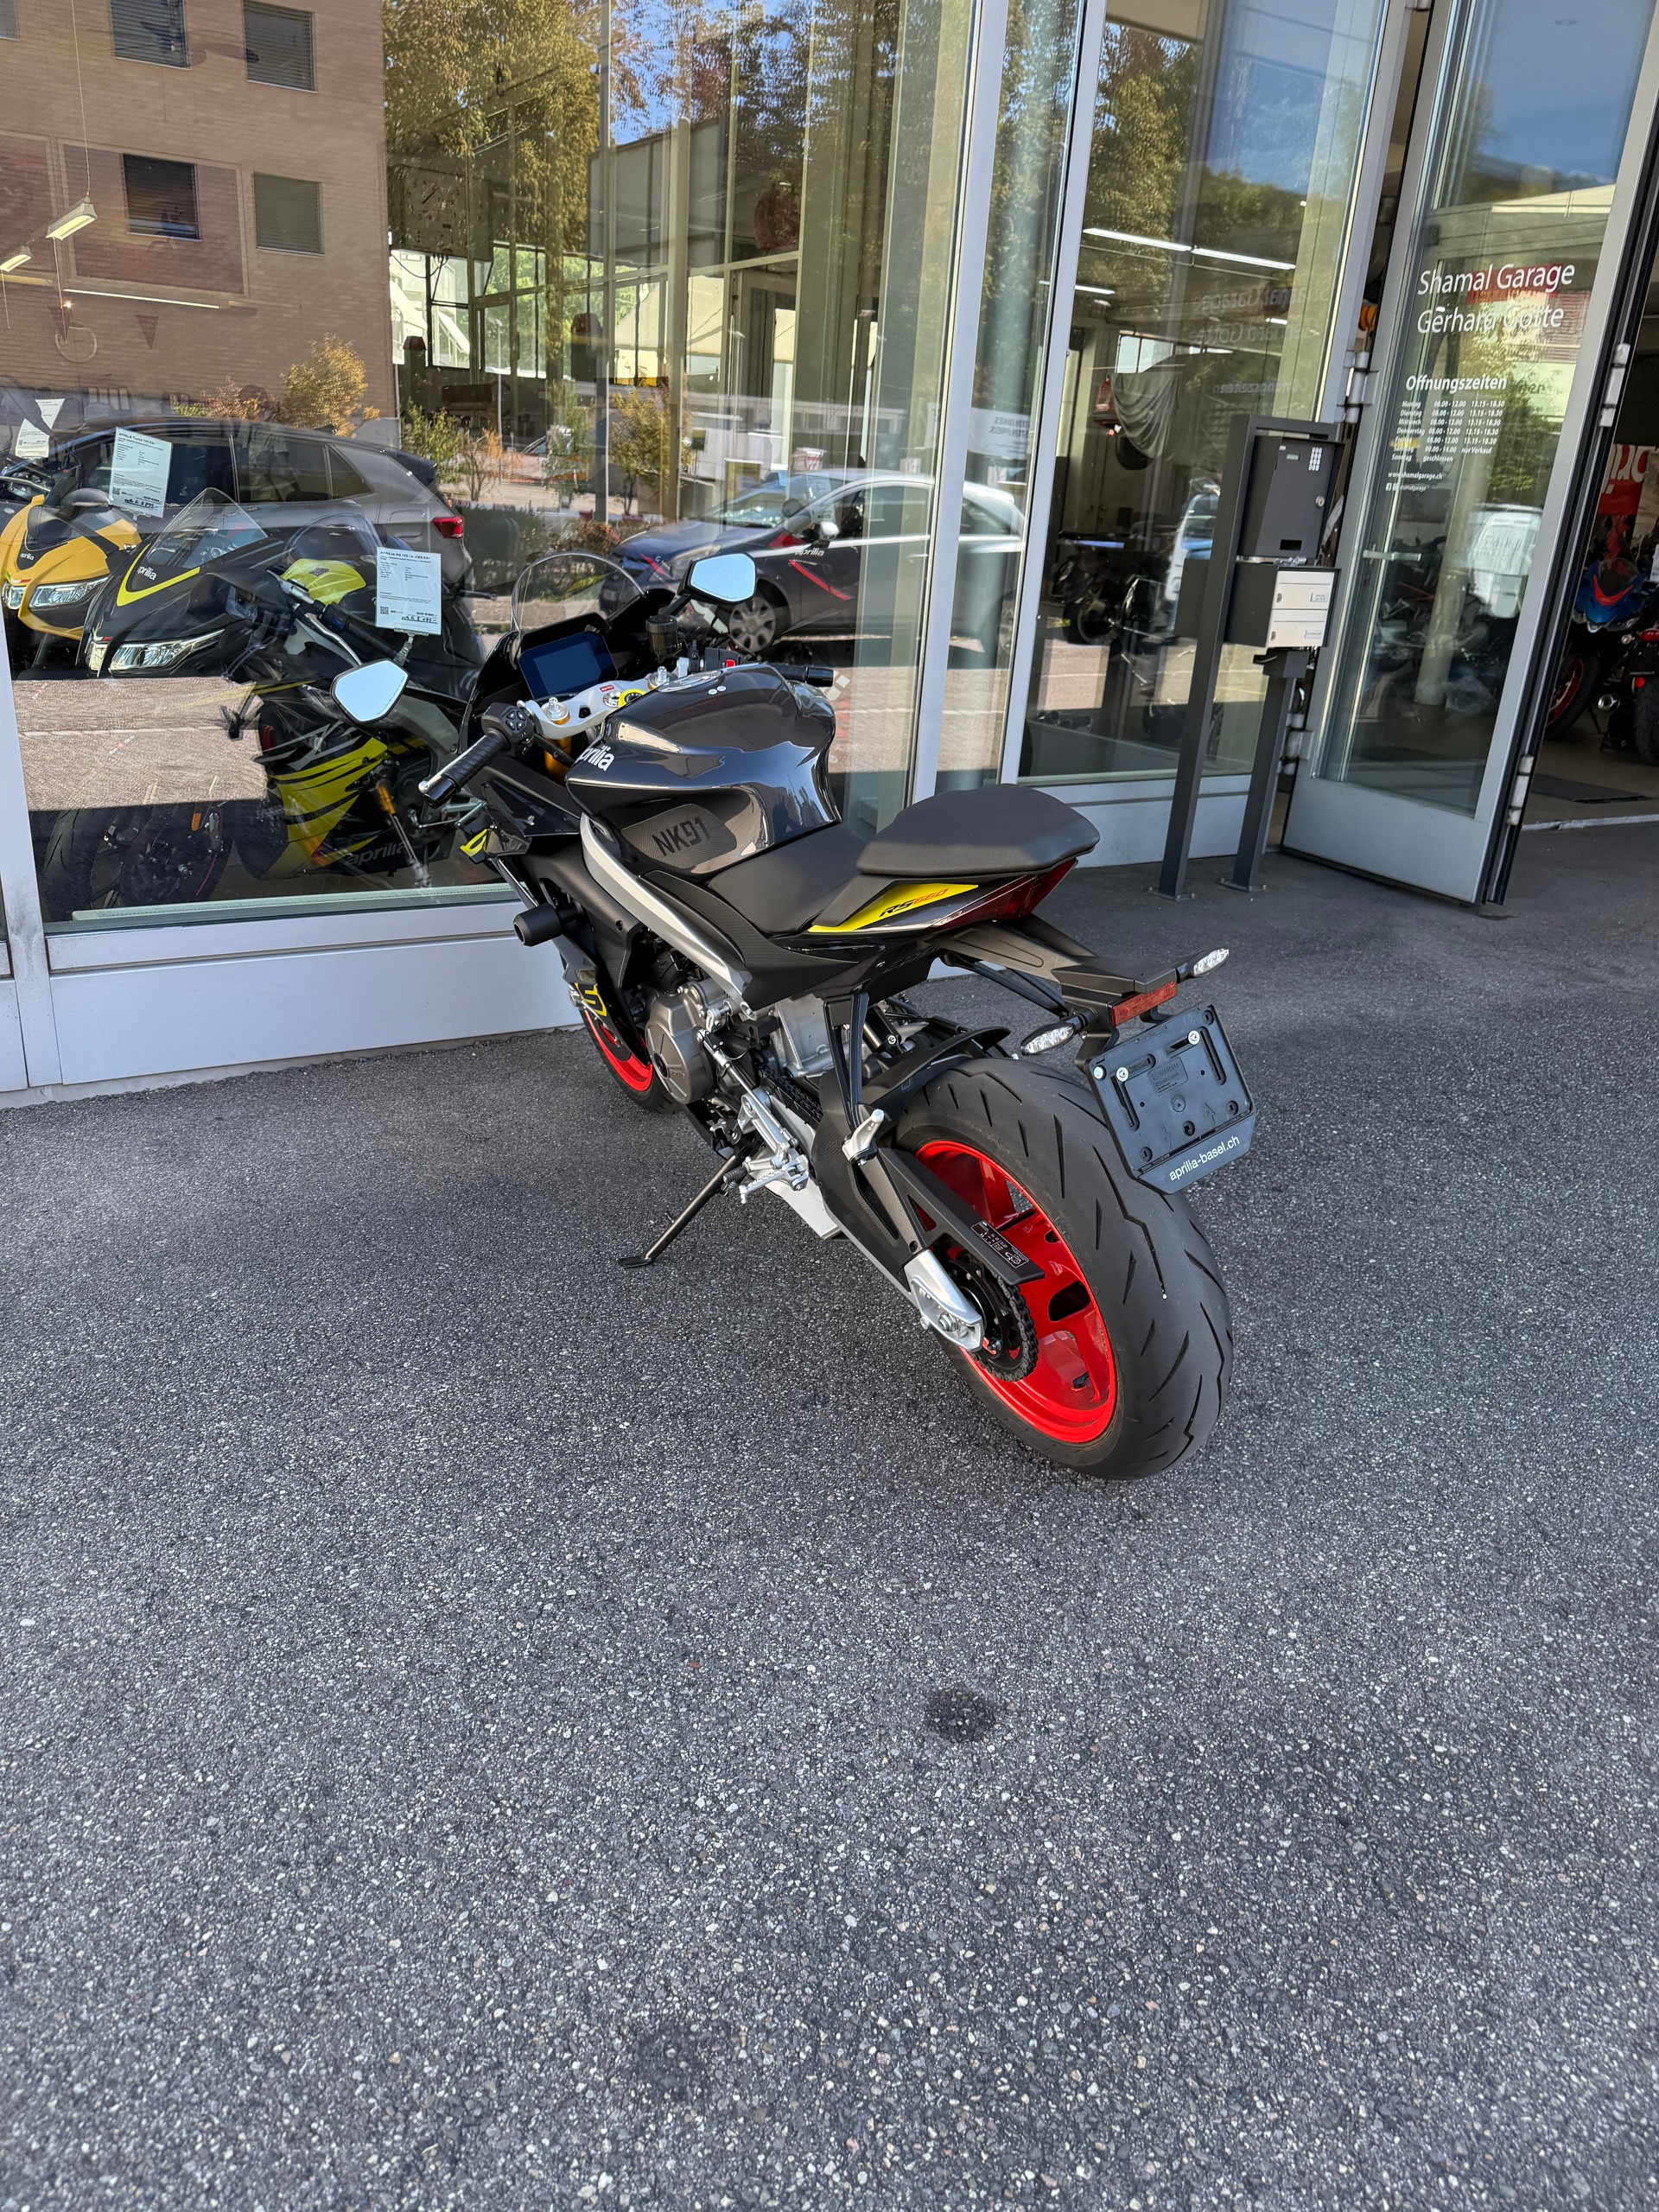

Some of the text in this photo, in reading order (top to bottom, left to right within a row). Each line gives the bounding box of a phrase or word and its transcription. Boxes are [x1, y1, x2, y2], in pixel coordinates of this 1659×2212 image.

[1418, 263, 1575, 295] Shamal Garage
[20, 552, 35, 561] aprilia
[795, 547, 825, 556] aprilia
[575, 745, 614, 772] prilia
[652, 816, 712, 857] NK91
[1169, 1135, 1241, 1181] aprilia-basel.ch
